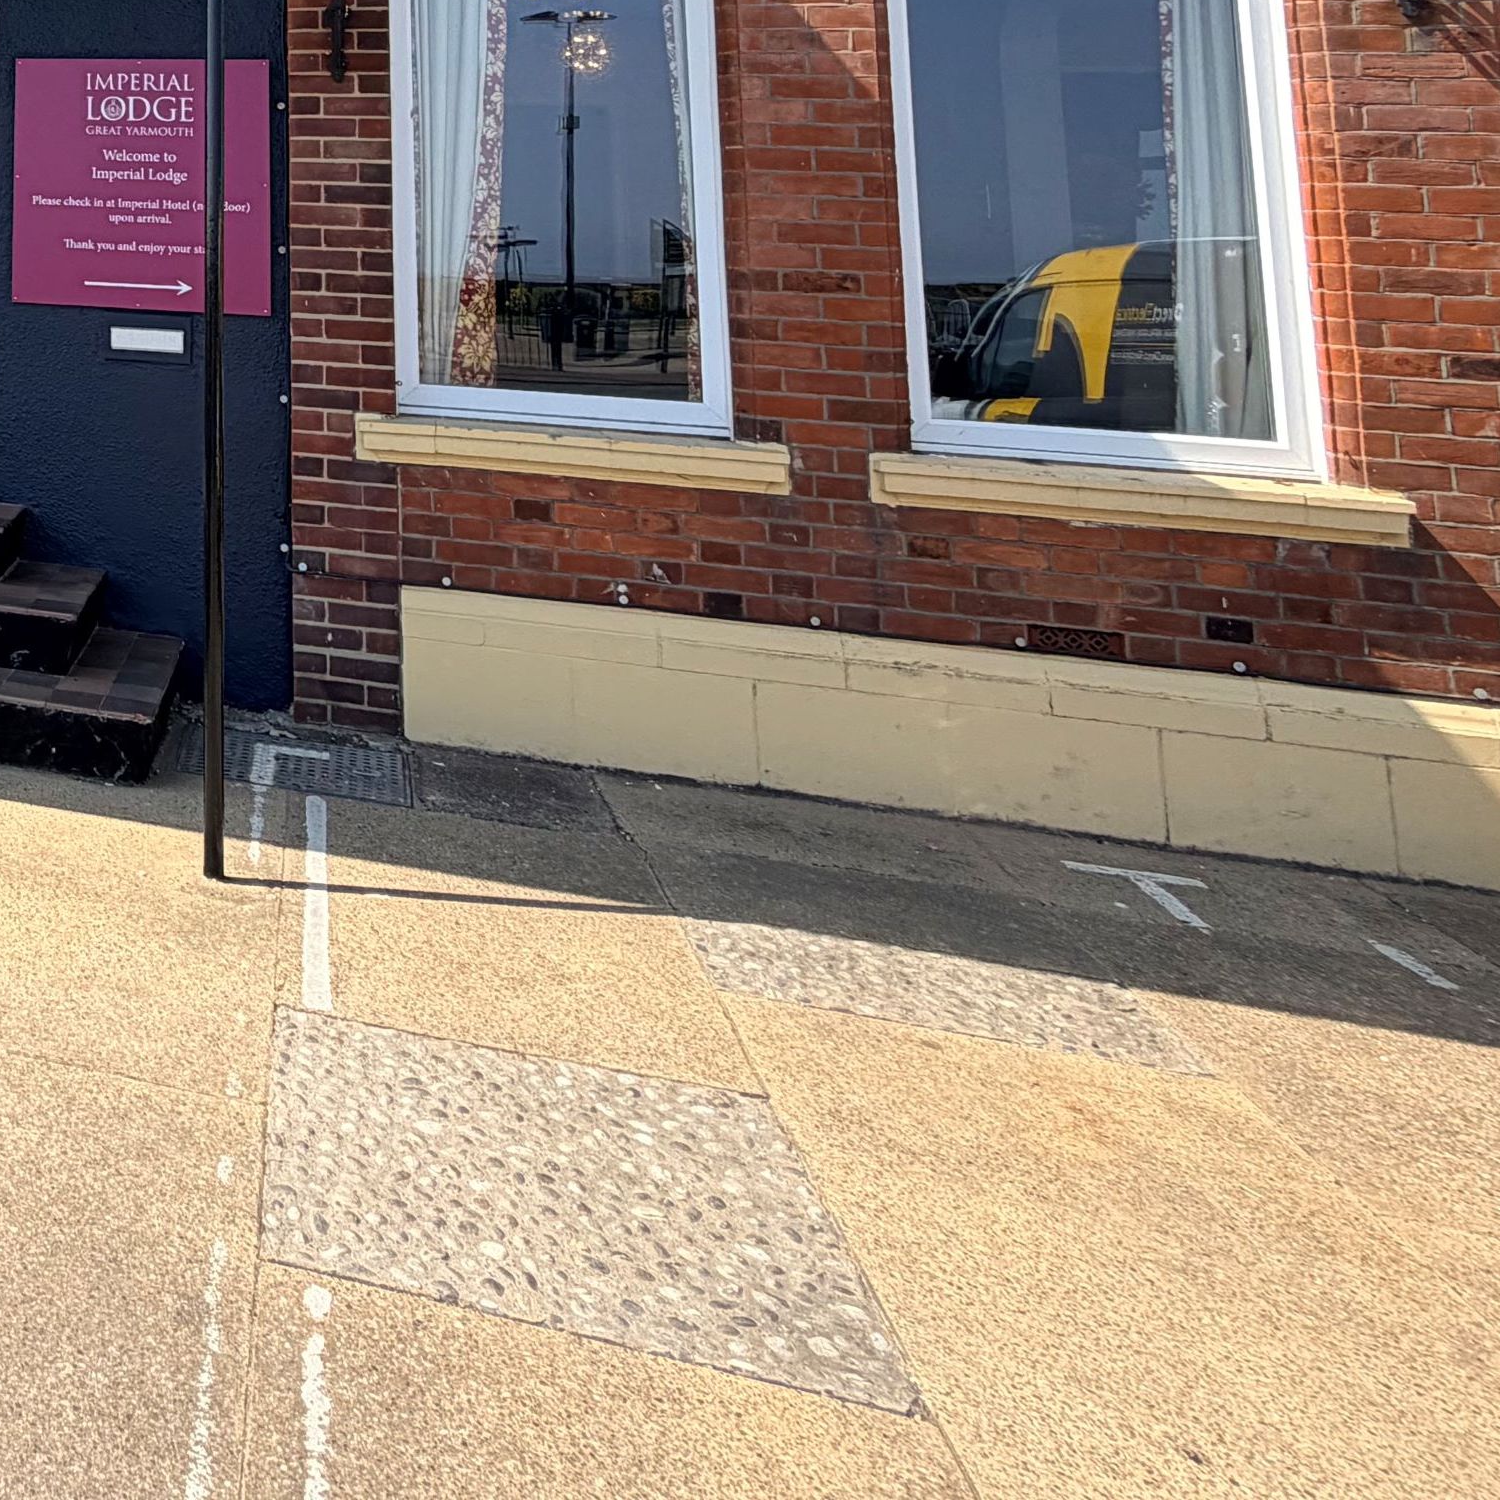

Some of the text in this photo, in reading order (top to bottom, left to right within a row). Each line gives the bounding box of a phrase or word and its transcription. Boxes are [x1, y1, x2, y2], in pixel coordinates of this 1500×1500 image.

[86, 73, 195, 92] IMPERIAL
[86, 96, 195, 122] LODGE
[85, 125, 195, 137] GREAT YARMOUTH
[103, 149, 177, 163] Welcome to
[91, 167, 188, 185] Imperial Lodge
[32, 195, 62, 206] Please
[63, 196, 92, 207] check
[94, 197, 104, 208] in
[106, 198, 116, 208] at
[118, 198, 160, 211] Imperial
[162, 200, 190, 211] Hotel
[109, 214, 173, 225] upon arrival.
[63, 238, 96, 250] Thank
[97, 243, 116, 253] you
[117, 241, 137, 251] and
[138, 242, 166, 255] enjoy
[168, 245, 191, 256] your
